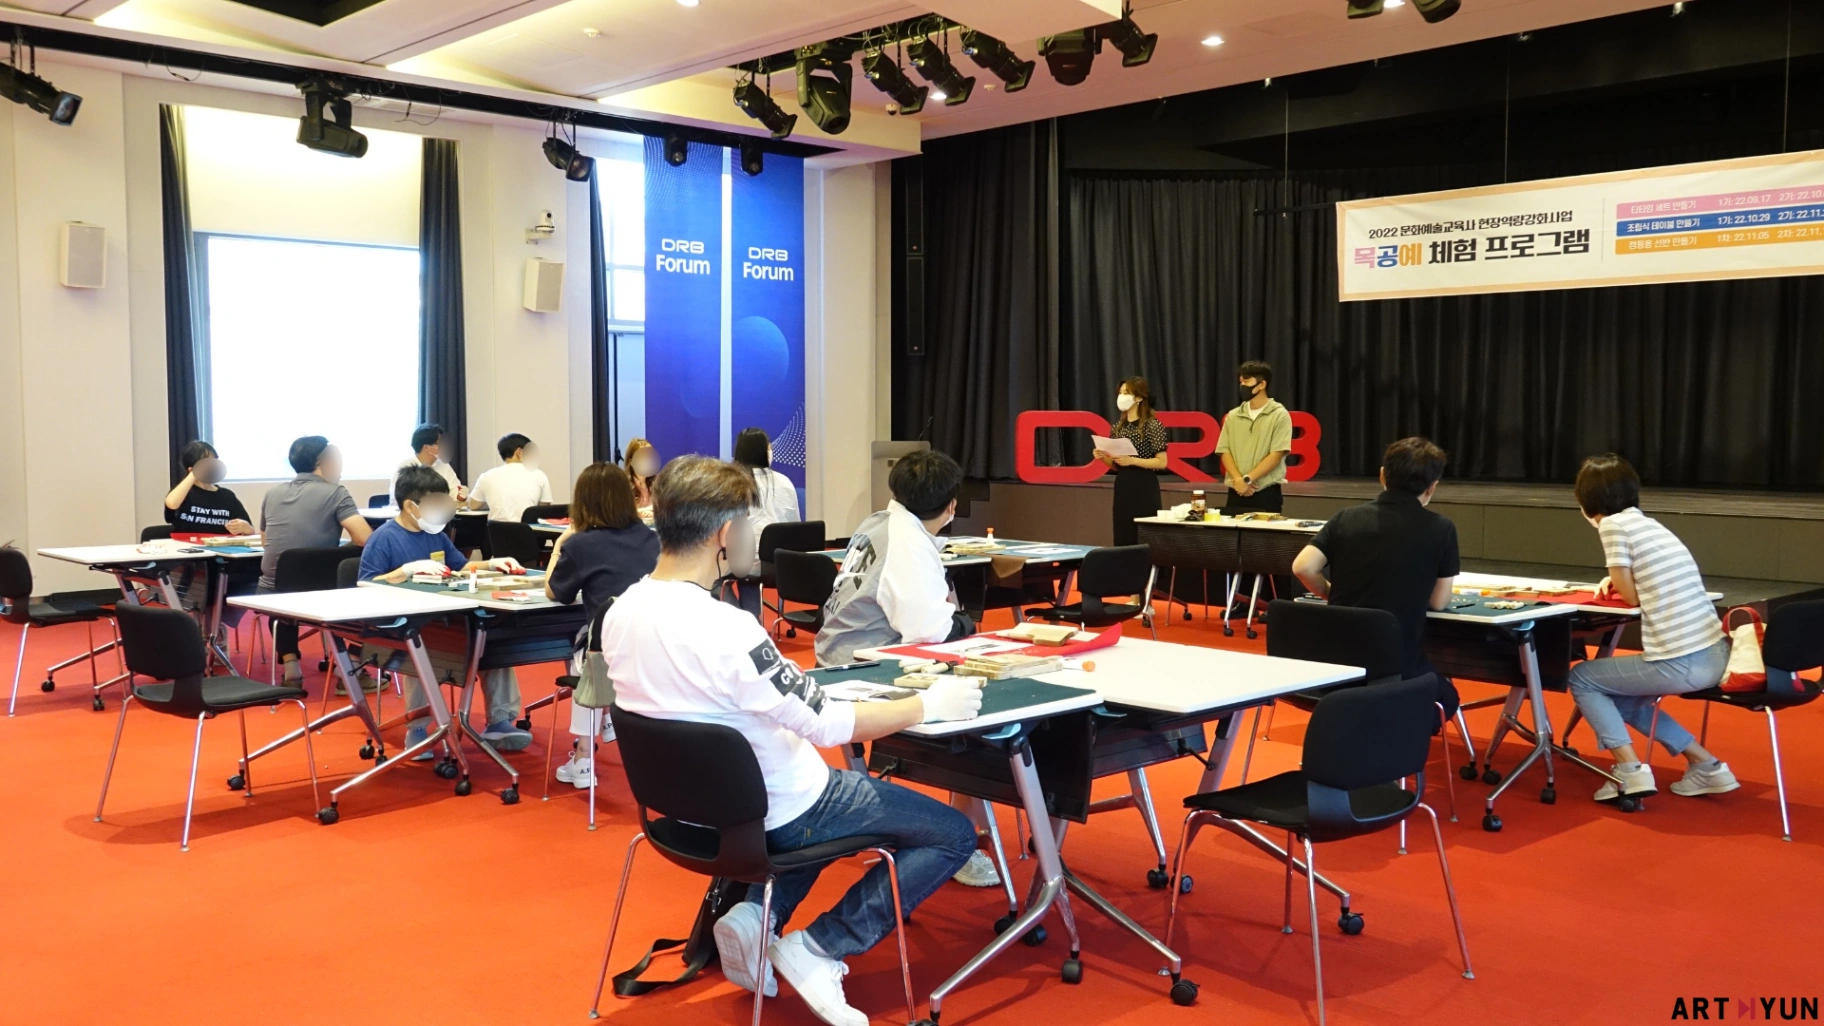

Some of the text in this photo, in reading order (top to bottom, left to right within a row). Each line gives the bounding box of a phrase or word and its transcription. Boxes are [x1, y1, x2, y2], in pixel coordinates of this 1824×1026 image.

[1672, 200, 1697, 211] 만들기
[1735, 194, 1771, 206] 22.09.17
[1797, 189, 1824, 201] 22.10.
[1368, 210, 1573, 240] 2022 문화예술교육사 현장역량강화사업
[1627, 222, 1650, 233] 조립식
[1651, 219, 1675, 231] 테이블
[1676, 217, 1700, 229] 만들기
[1734, 213, 1771, 224] 22.10.29
[661, 238, 705, 254] DRB
[1672, 235, 1697, 247] 만들기
[1733, 231, 1770, 242] 22.11.05
[1795, 226, 1824, 238] 22.11.
[748, 247, 788, 262] DRB
[1354, 228, 1591, 269] 목공예 체험 프로그램
[655, 254, 711, 275] Forum
[743, 261, 794, 281] Forum
[191, 506, 230, 517] STAY WITH
